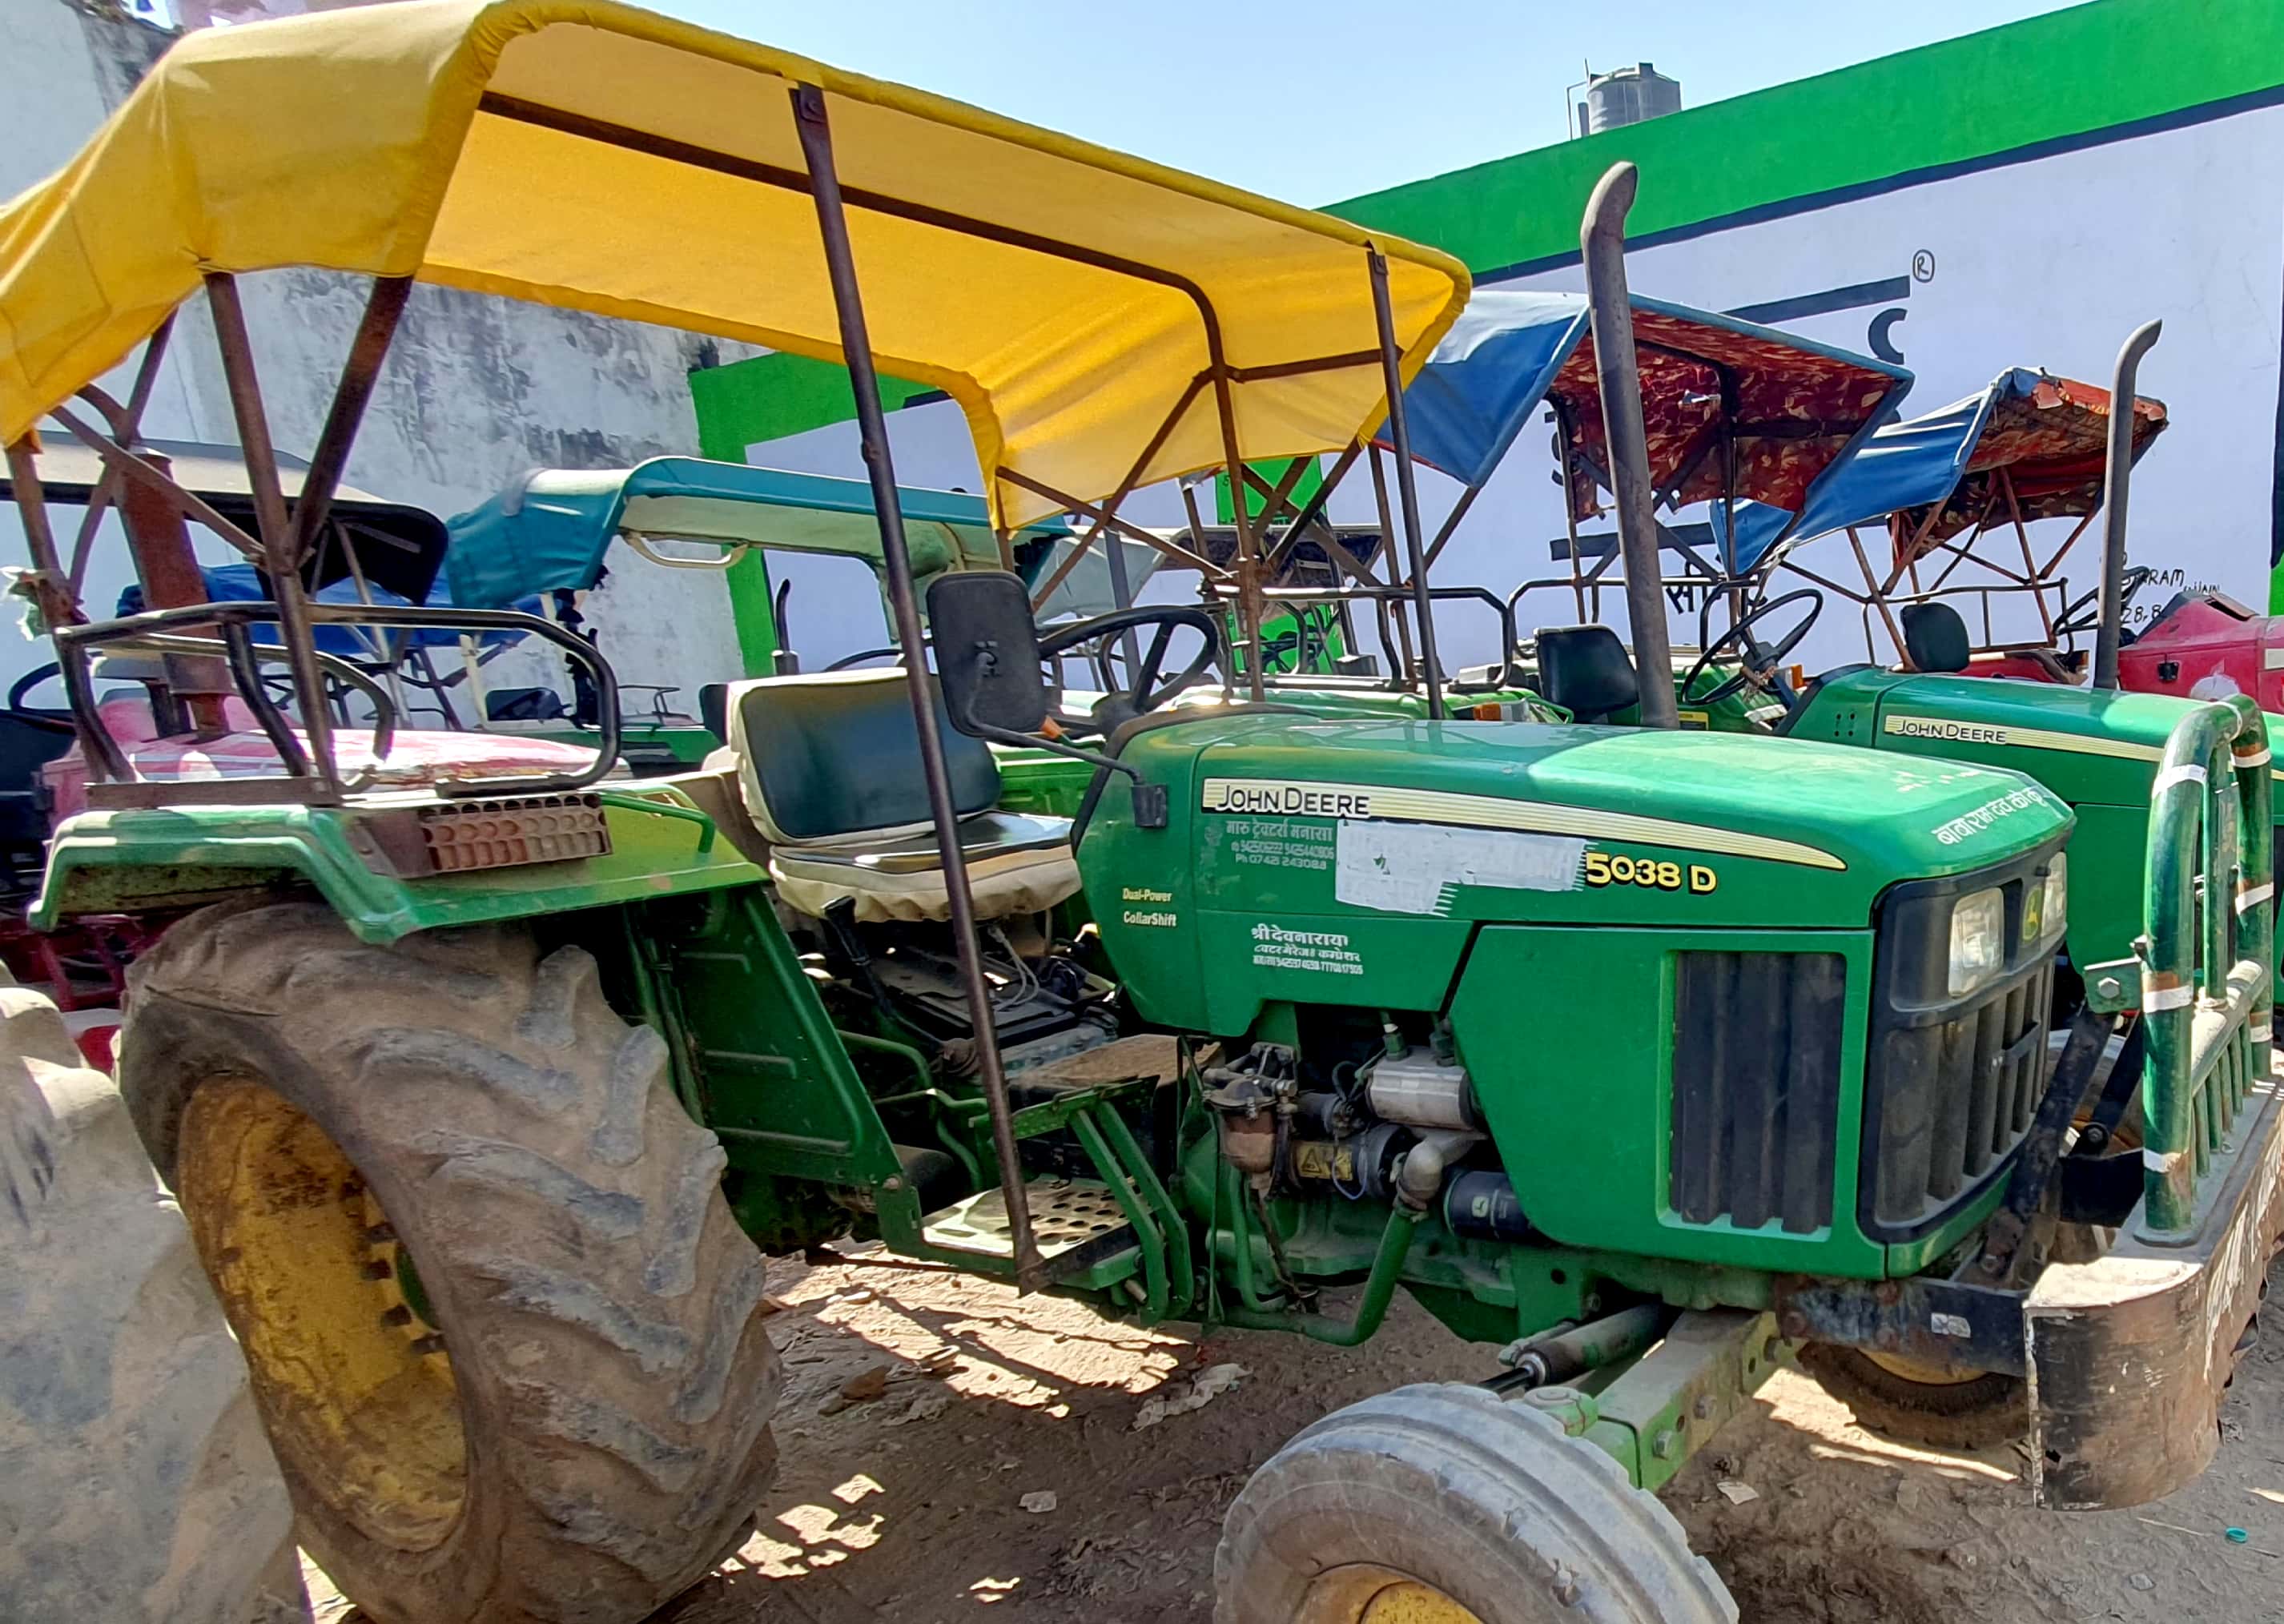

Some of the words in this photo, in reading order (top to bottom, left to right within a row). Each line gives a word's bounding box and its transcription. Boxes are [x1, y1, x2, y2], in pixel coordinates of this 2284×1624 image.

[1896, 719, 1943, 736] JOHN
[1946, 723, 2006, 743] DEERE
[1216, 785, 1280, 811] JOHN
[1285, 787, 1369, 815] DEERE
[1586, 851, 1682, 888] 5038
[1690, 864, 1717, 892] D
[1122, 887, 1173, 902] Dual-Power
[1123, 910, 1177, 927] CollarShift
